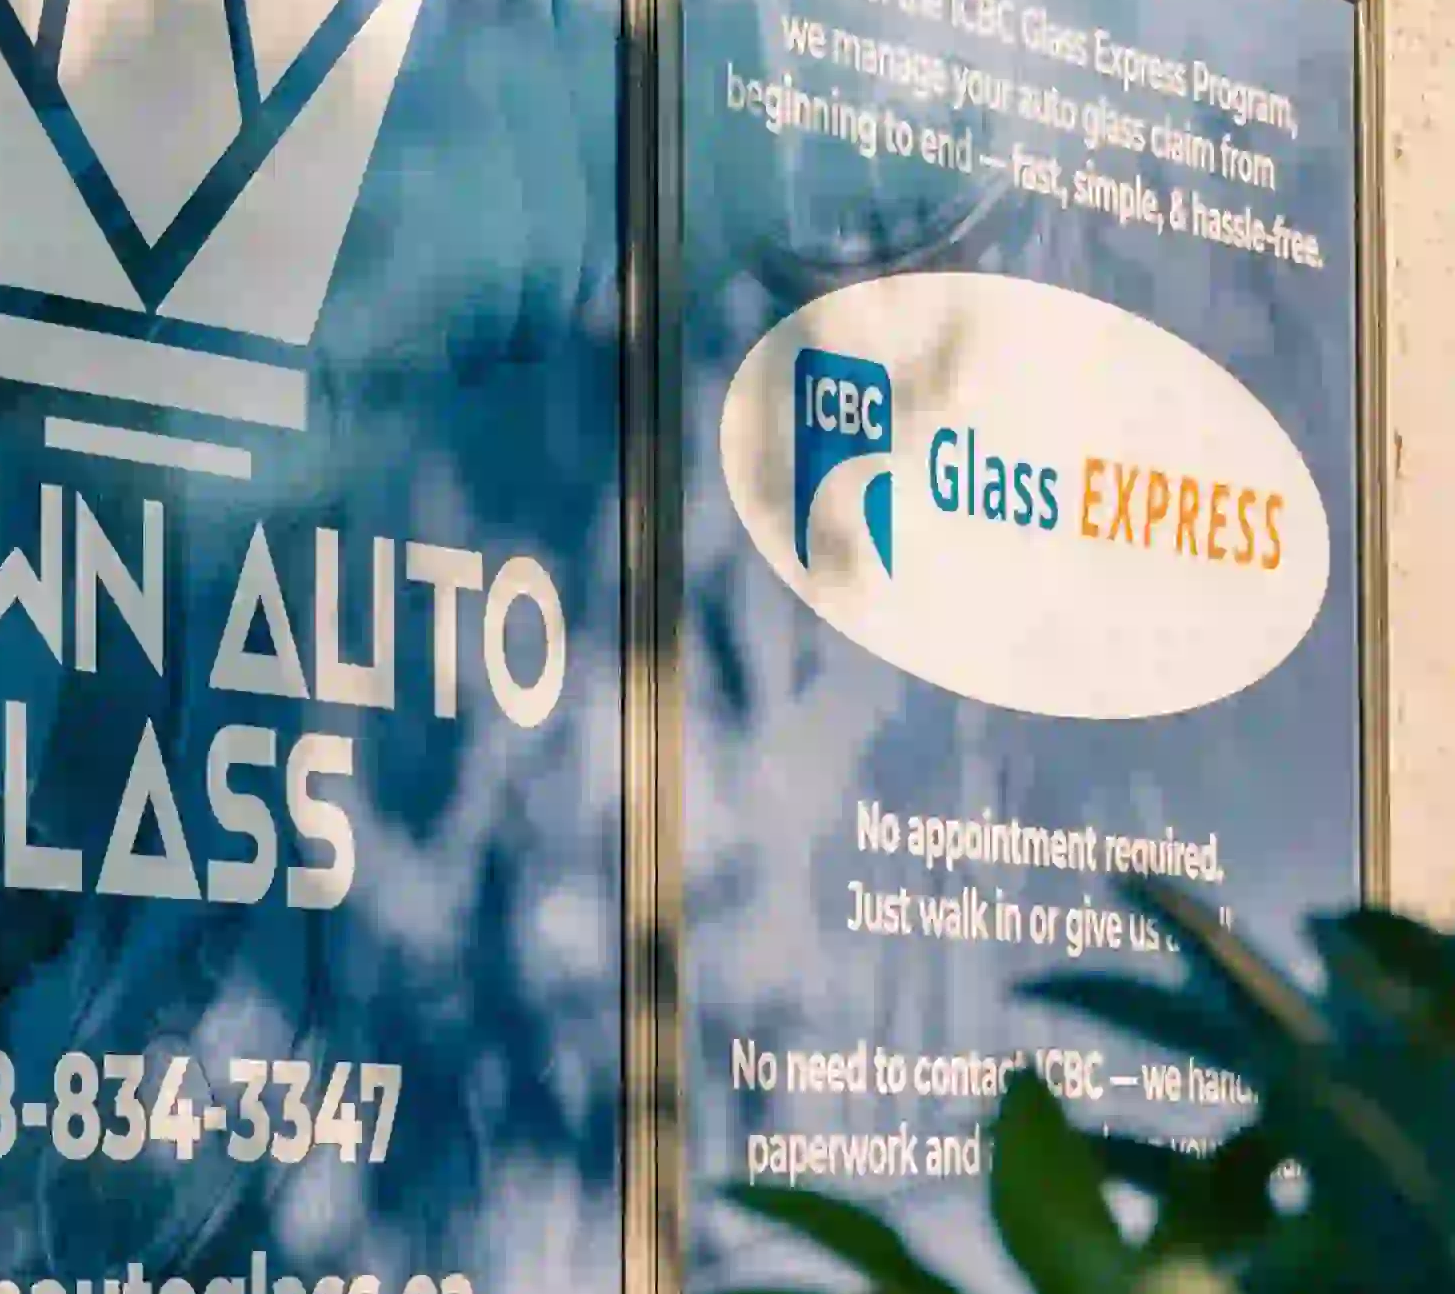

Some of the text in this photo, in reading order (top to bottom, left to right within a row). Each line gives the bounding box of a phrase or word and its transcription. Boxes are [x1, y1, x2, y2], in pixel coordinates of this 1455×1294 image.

[781, 15, 1276, 190] we manage your auto glass claim from
[1021, 6, 1088, 67] Glass
[1093, 28, 1187, 97] Express
[1193, 60, 1299, 141] Program,
[727, 61, 878, 159] beginning
[883, 109, 914, 157] to
[920, 125, 973, 174] end
[1011, 141, 1069, 210] fast,
[1072, 158, 1165, 236] simple,
[1169, 188, 1188, 232] &
[1192, 190, 1325, 269] hassle-free.
[805, 374, 884, 440] ICBC
[929, 425, 1284, 570] Glass EXPRESS
[208, 521, 566, 728] AUTO
[857, 800, 1225, 885] No appointment required.
[847, 880, 911, 936] Just
[919, 886, 990, 941] walk
[995, 888, 1021, 944] in
[1029, 904, 1059, 946] or
[1066, 895, 1123, 958] give
[1129, 911, 1160, 953] us
[732, 1038, 777, 1092] No
[787, 1038, 868, 1094] need
[873, 1046, 907, 1095] to
[1142, 1063, 1182, 1102] we
[748, 1118, 919, 1187] paperwork
[925, 1121, 980, 1177] and
